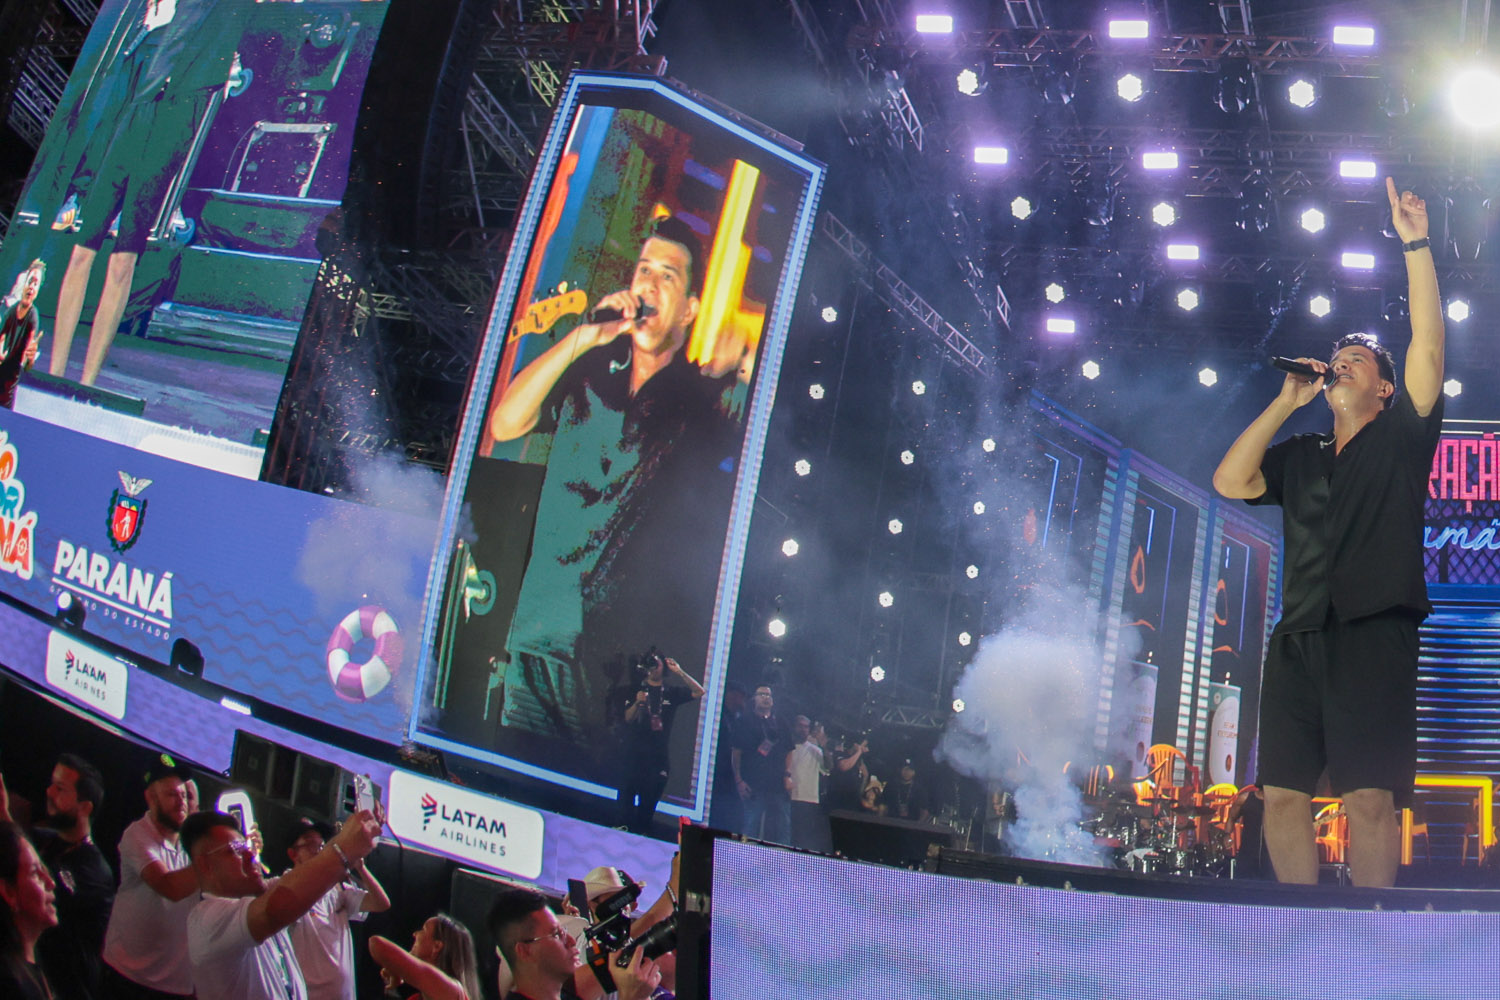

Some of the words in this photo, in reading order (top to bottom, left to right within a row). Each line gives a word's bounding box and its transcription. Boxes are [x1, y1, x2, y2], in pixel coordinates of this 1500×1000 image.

[53, 540, 174, 619] PARANÁ
[125, 616, 170, 640] ESTADO
[76, 658, 107, 685] LAAM
[441, 804, 507, 838] LATAM
[440, 827, 507, 857] AIRLINES
